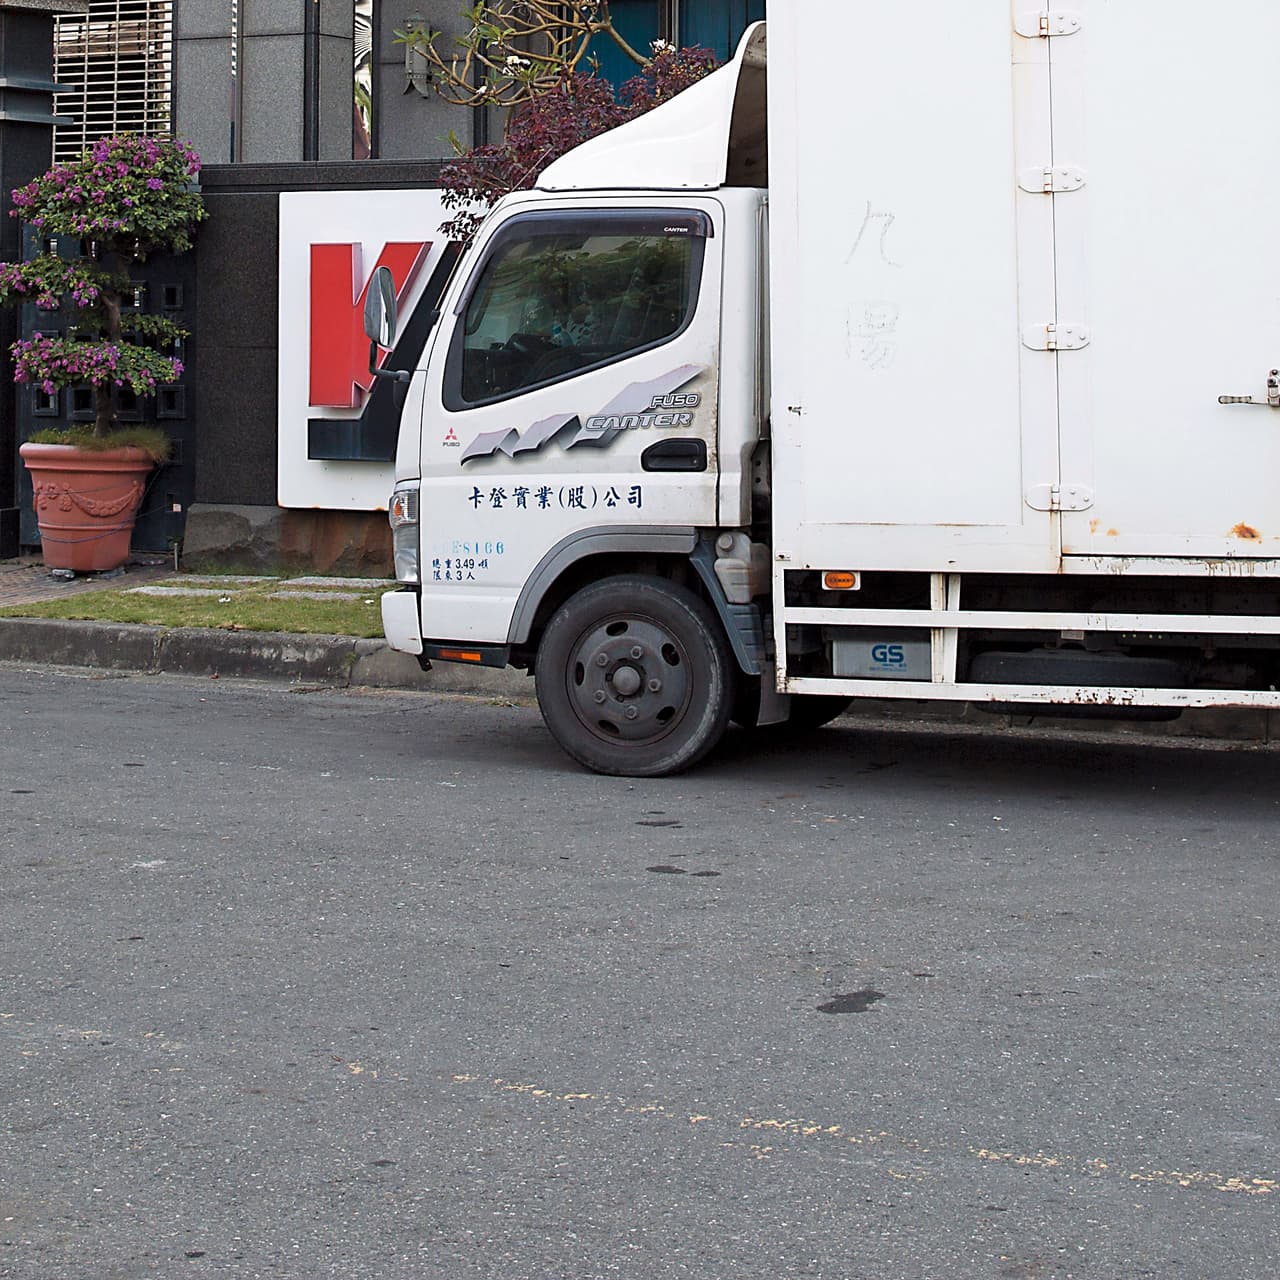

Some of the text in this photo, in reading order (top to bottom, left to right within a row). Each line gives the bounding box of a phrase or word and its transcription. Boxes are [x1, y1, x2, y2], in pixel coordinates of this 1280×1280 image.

[650, 392, 701, 409] FUSO
[585, 412, 694, 432] CANTER
[468, 484, 643, 510] 卡登實業(股)公司
[872, 645, 904, 663] GS
